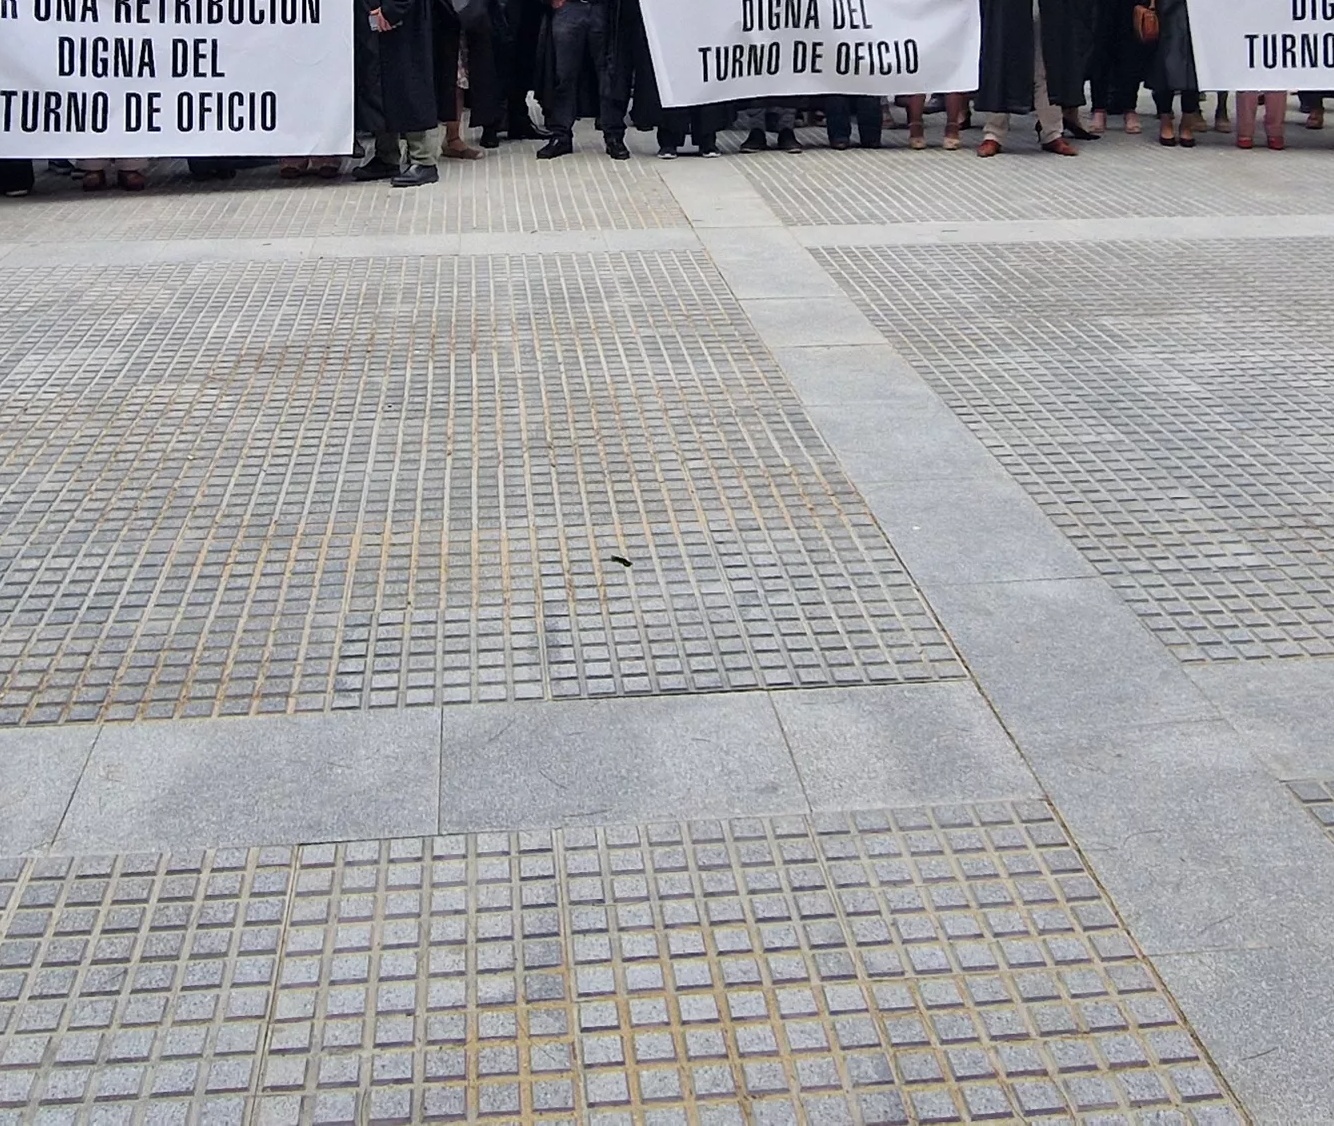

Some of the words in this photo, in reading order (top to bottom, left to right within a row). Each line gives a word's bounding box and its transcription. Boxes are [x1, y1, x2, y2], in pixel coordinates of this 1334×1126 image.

[59, 37, 155, 78] DIGNA
[172, 39, 225, 77] DEL
[698, 42, 780, 82] TURNO
[793, 41, 823, 73] DE
[836, 39, 918, 75] OFICIO
[0, 90, 108, 133] TURNO
[126, 93, 161, 132] DE
[178, 92, 276, 132] OFICIO
